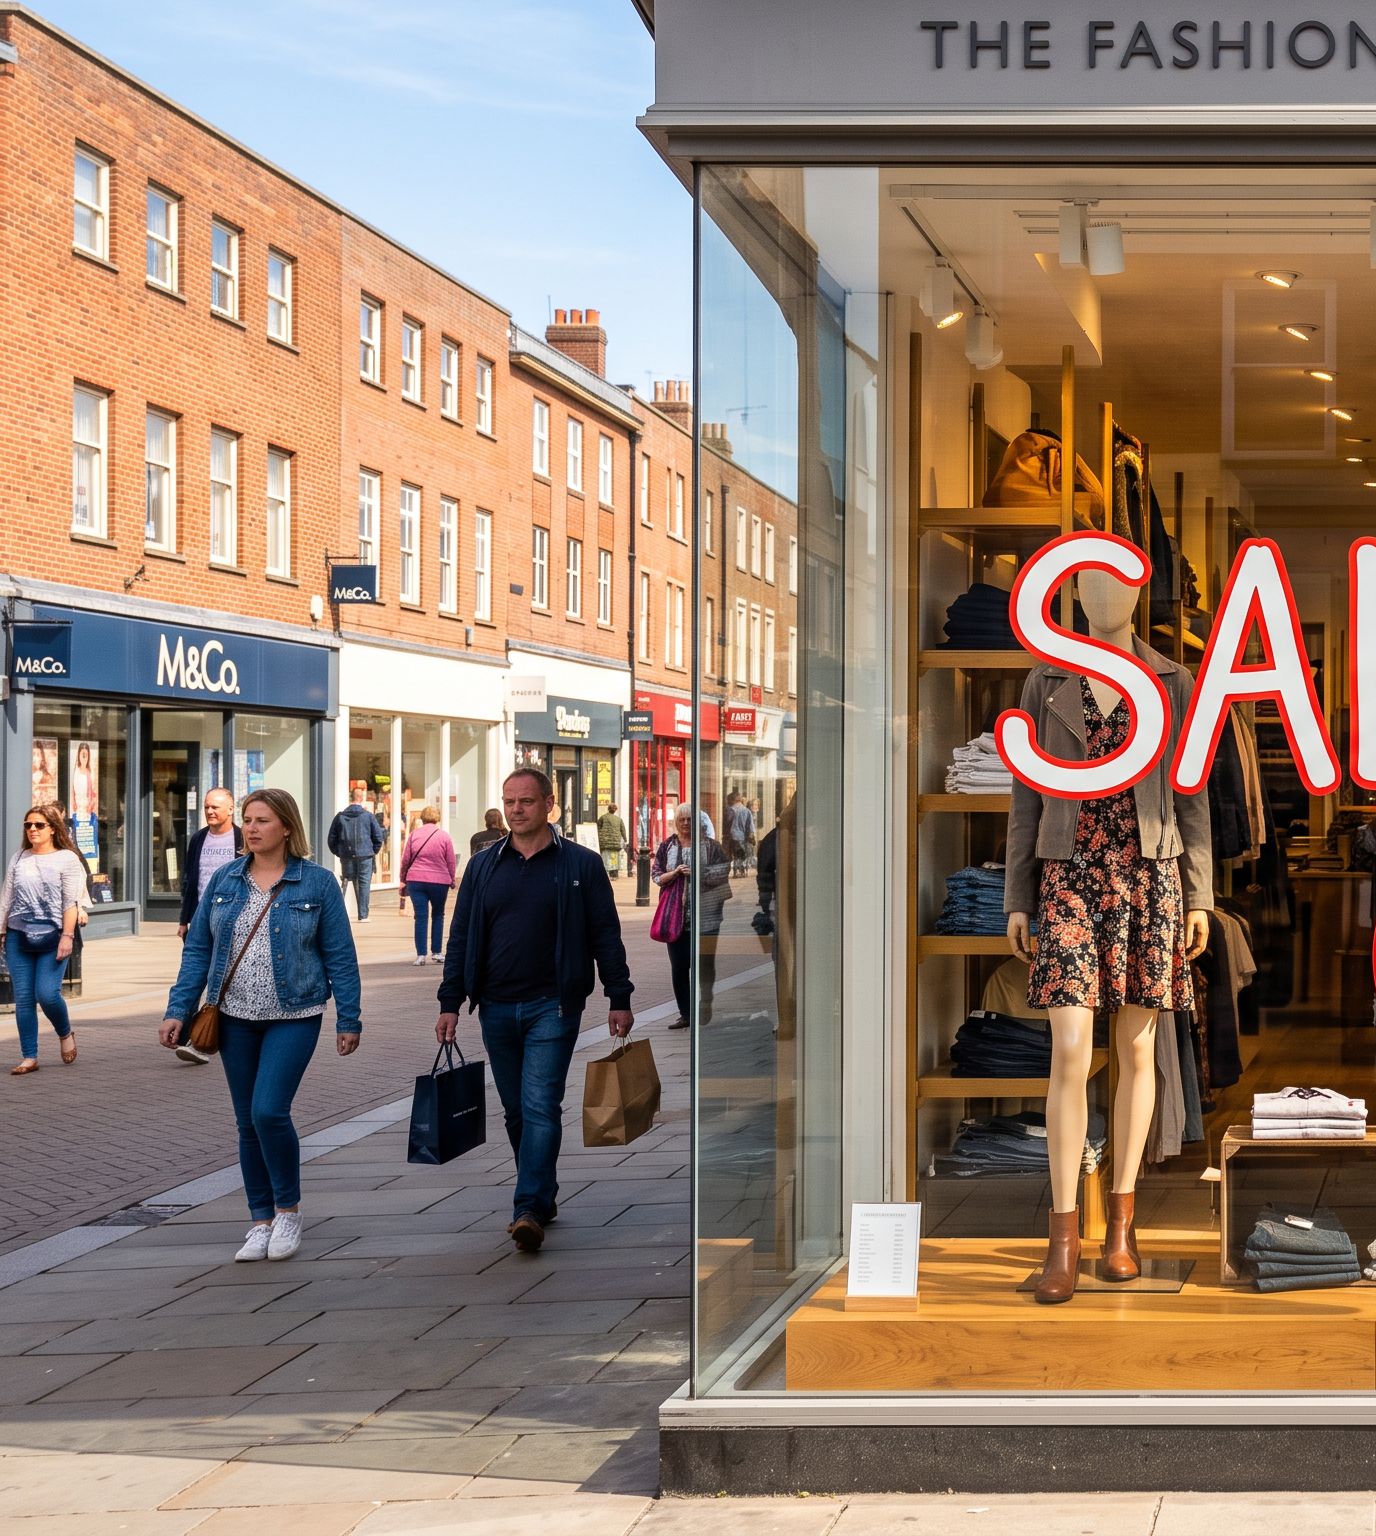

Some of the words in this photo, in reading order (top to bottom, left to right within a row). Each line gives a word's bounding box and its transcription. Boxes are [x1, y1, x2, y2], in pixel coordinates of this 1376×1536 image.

[920, 20, 1051, 70] THE
[15, 656, 67, 674] M&Co.
[156, 633, 242, 695] M&Co.
